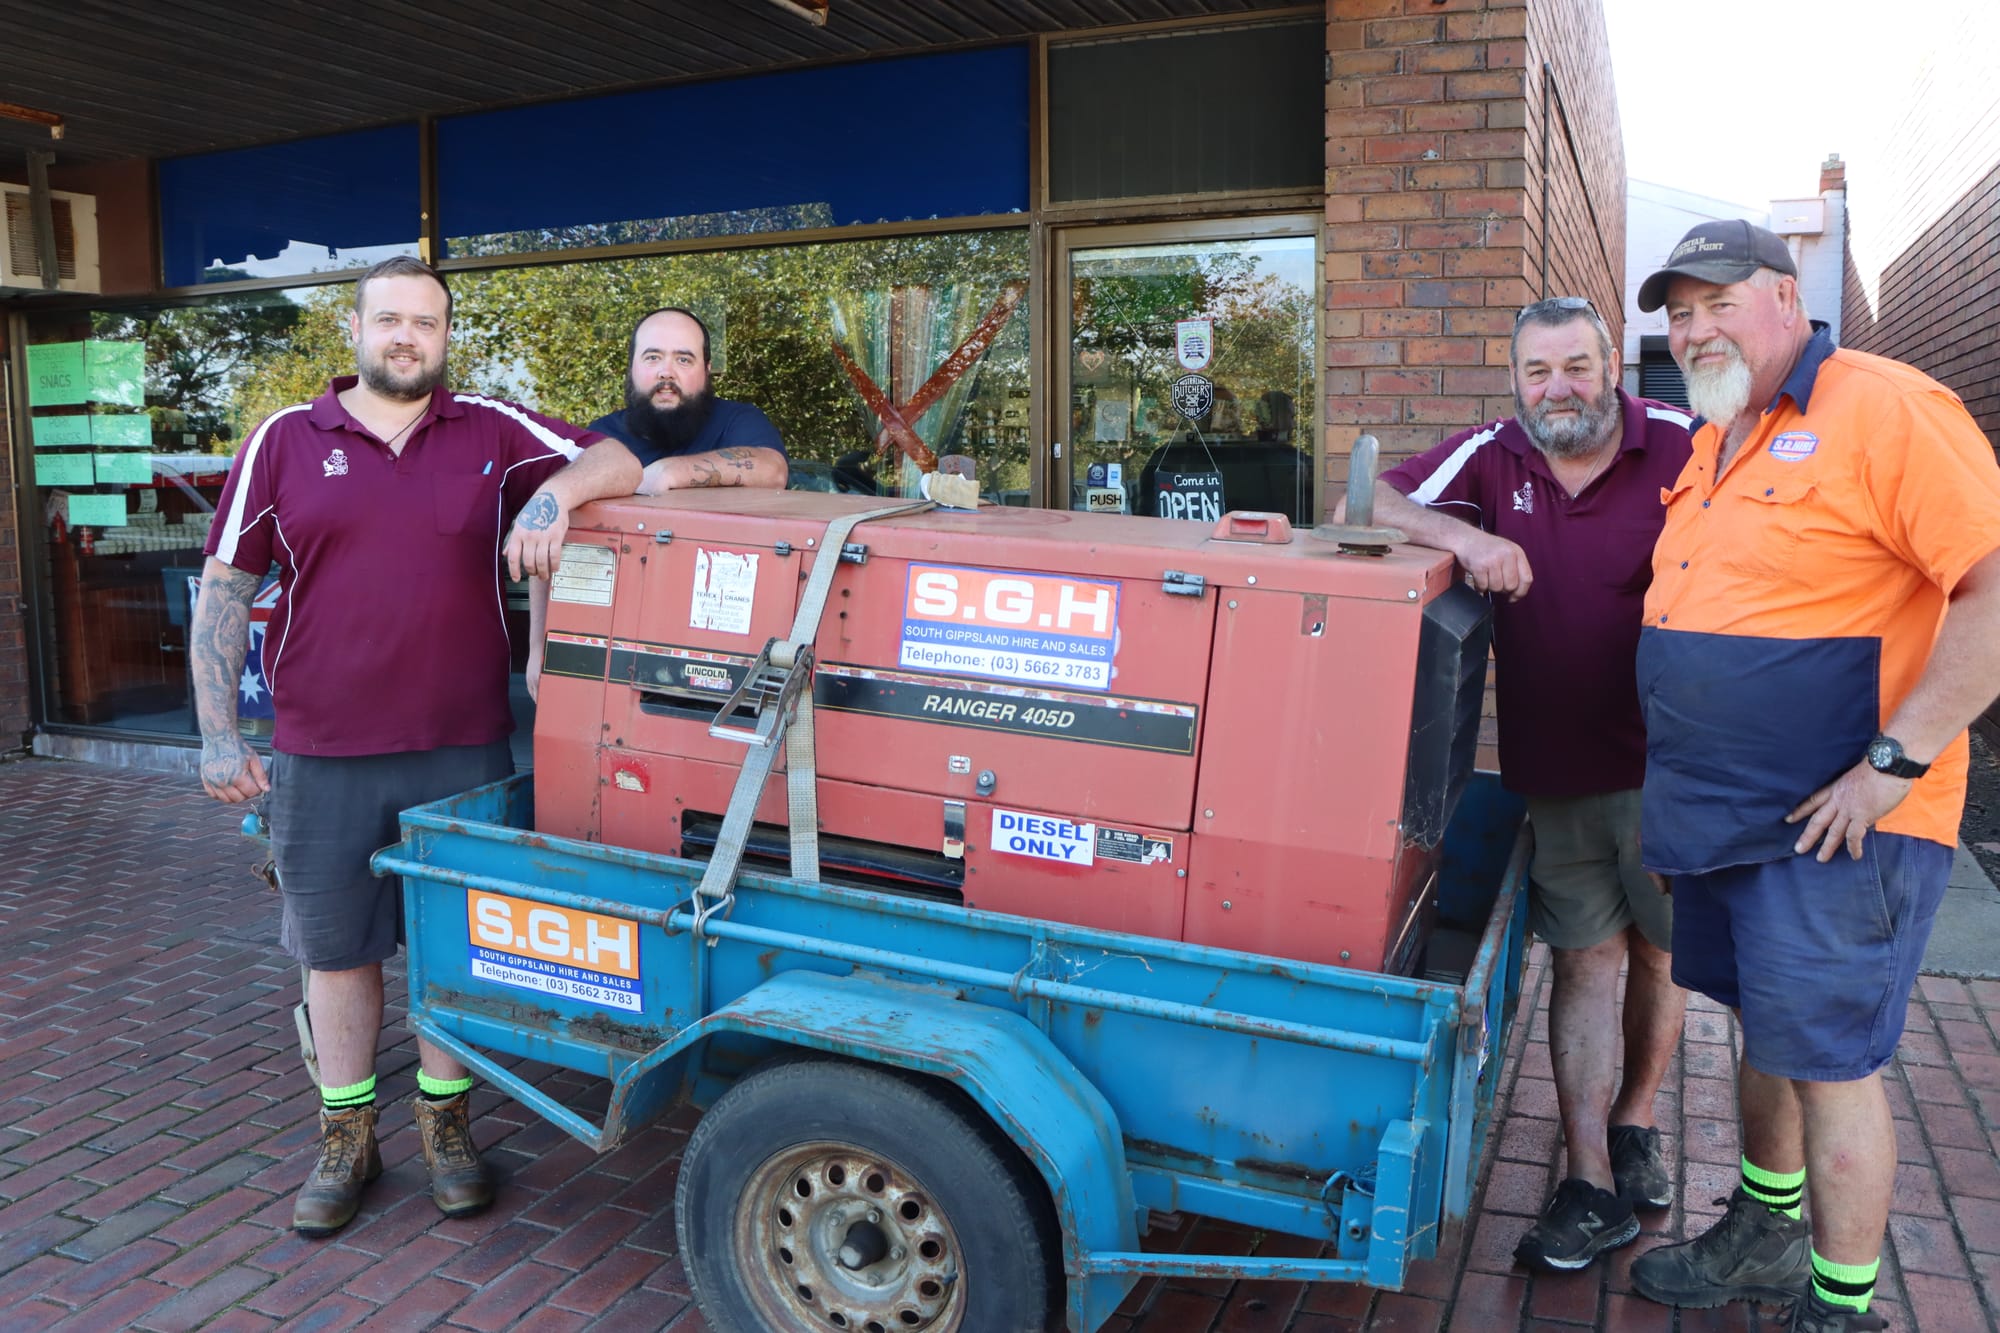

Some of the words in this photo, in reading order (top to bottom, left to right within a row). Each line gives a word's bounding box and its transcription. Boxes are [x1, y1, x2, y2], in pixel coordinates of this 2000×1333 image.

[1699, 242, 1724, 251] POINT
[39, 374, 72, 389] SNACS
[1184, 407, 1201, 417] GUILD
[1174, 475, 1204, 487] Come
[1207, 474, 1220, 486] in
[1090, 494, 1122, 505] PUSH
[1159, 490, 1220, 523] OPEN
[913, 572, 1110, 633] S.G.H
[905, 625, 943, 640] SOUTH
[945, 629, 1009, 647] GIPPSLAND
[1012, 636, 1039, 649] HIRE
[1042, 639, 1066, 652] AND
[1069, 642, 1106, 657] SALES
[686, 666, 725, 679] LINCOLN
[905, 646, 986, 667] Telephone:
[990, 656, 1019, 674] (03)
[1024, 659, 1060, 676] 5662
[1064, 664, 1101, 681] 3783
[923, 694, 1018, 721] RANGER
[1021, 707, 1075, 728] 405D
[1000, 814, 1089, 842] DIESEL
[1009, 836, 1076, 860] ONLY
[477, 897, 631, 970] S.G.H
[479, 950, 505, 963] SOUTH
[508, 956, 556, 974] GIPPSLAND
[558, 967, 578, 979] HIRE
[582, 972, 599, 983] AND
[603, 976, 632, 989] SALES
[480, 962, 542, 986] Telephone:
[546, 979, 568, 994] (03)
[572, 984, 600, 998] 5662
[603, 989, 632, 1005] 3783
